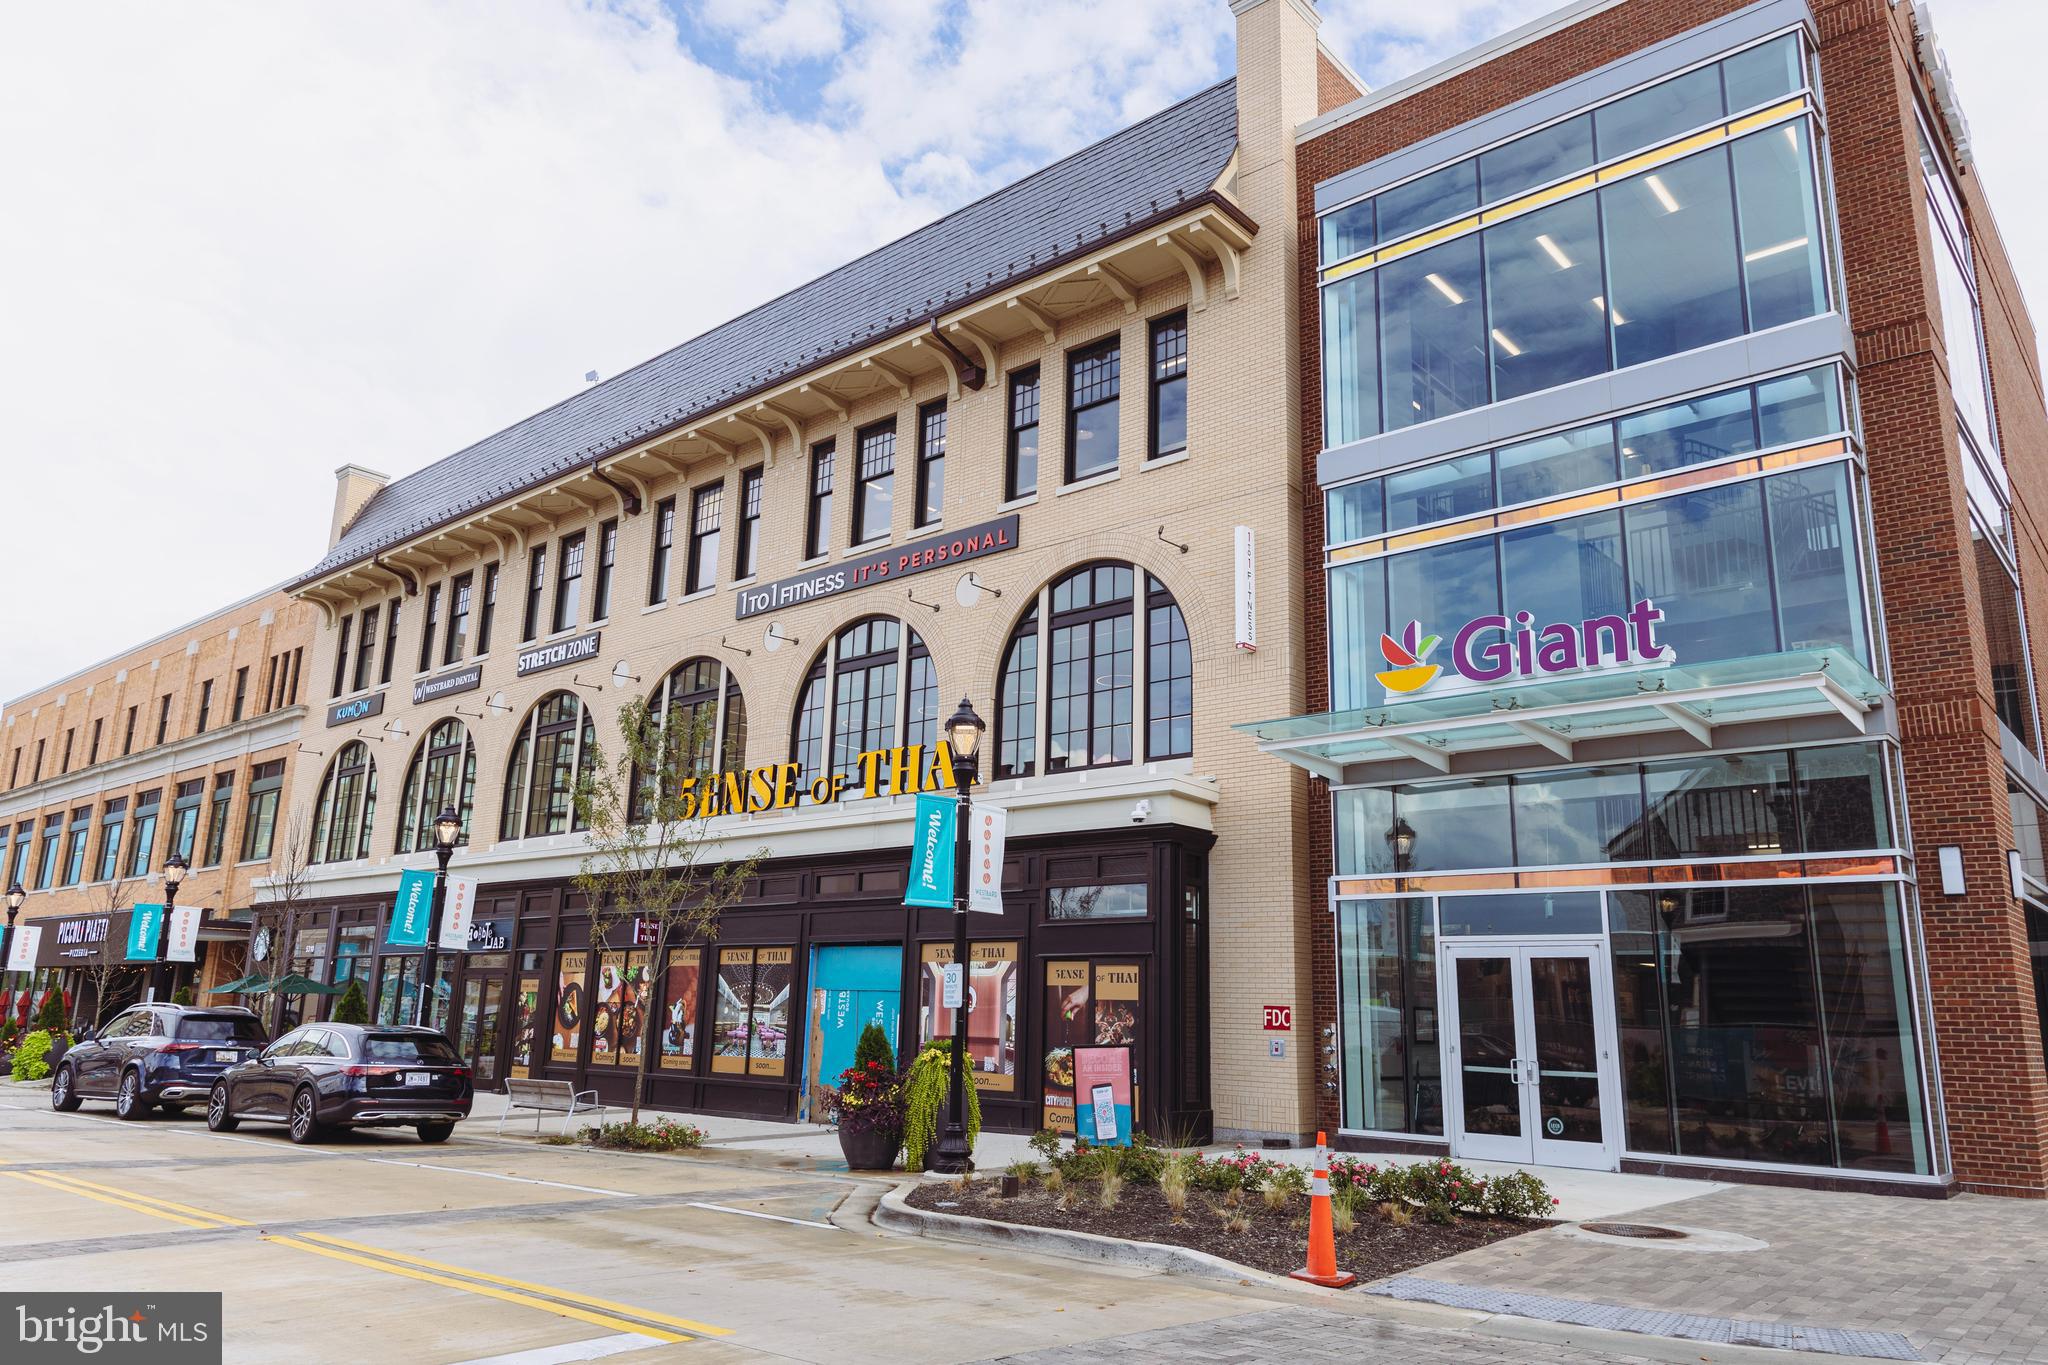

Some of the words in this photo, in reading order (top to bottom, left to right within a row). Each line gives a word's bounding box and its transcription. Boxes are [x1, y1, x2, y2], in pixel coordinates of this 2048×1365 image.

[780, 572, 845, 604] FITNESS
[852, 560, 889, 583] IT'S
[899, 528, 1009, 571] PERSONAL
[1452, 598, 1672, 682] Giant
[518, 644, 567, 672] STRETCH
[567, 635, 597, 658] ZONE
[425, 678, 455, 695] WESTBARD
[455, 672, 479, 687] DENTAL
[336, 700, 371, 719] KUMON
[810, 774, 848, 805] OF
[857, 740, 976, 799] THA
[922, 809, 942, 891] Welcome!
[403, 880, 423, 935] Welcome!
[57, 920, 85, 944] PICCOLI
[84, 918, 109, 942] PIATTI
[138, 911, 153, 952] Welcome!
[767, 951, 787, 961] THAI
[981, 948, 1005, 958] THAI
[946, 972, 957, 983] 30
[1108, 972, 1138, 984] THAI
[1263, 1009, 1291, 1027] FDC
[1049, 1112, 1075, 1124] Comi
